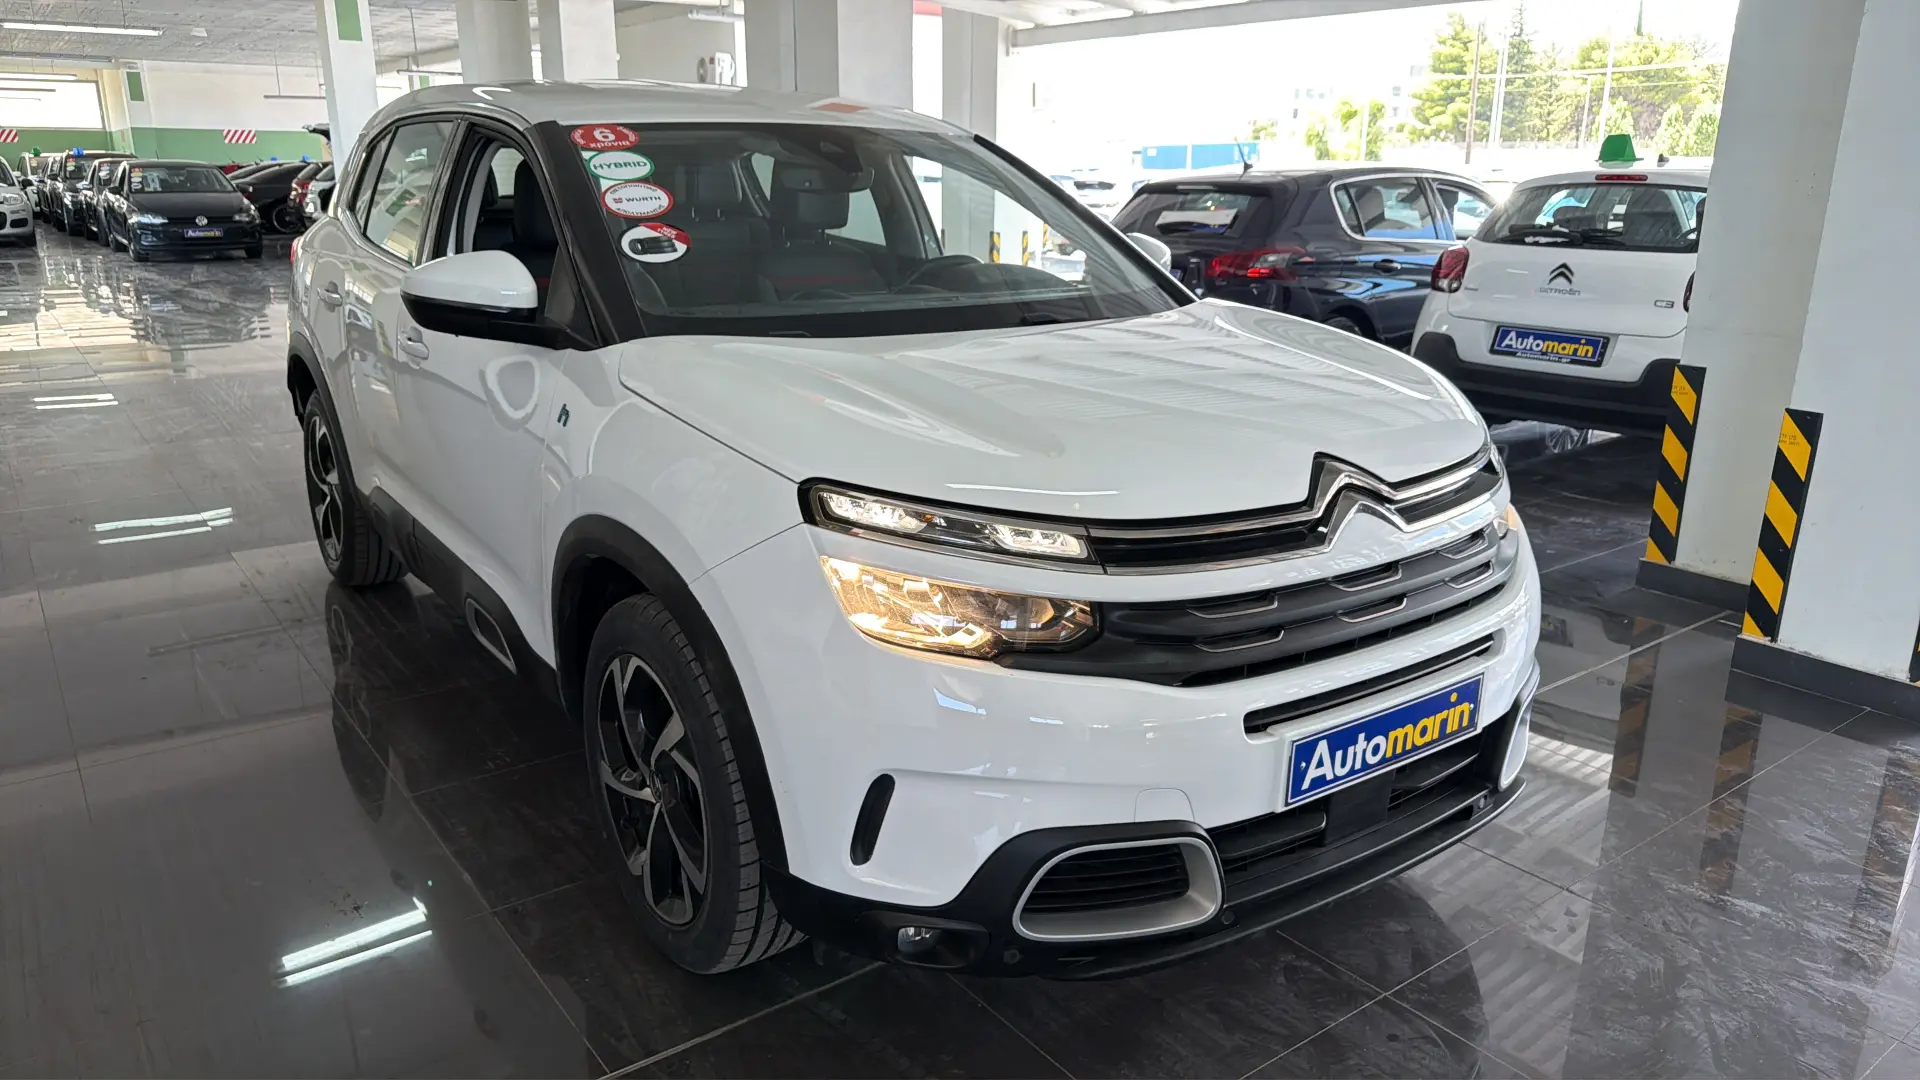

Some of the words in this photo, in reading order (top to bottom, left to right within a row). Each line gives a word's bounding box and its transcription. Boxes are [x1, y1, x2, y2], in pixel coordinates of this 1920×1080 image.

[593, 127, 616, 142] 6
[593, 161, 648, 170] HYBRID
[1654, 299, 1675, 309] C3
[1501, 330, 1594, 358] Automarin
[1516, 351, 1572, 364] Automarin.gr
[1300, 692, 1472, 791] Automarin
